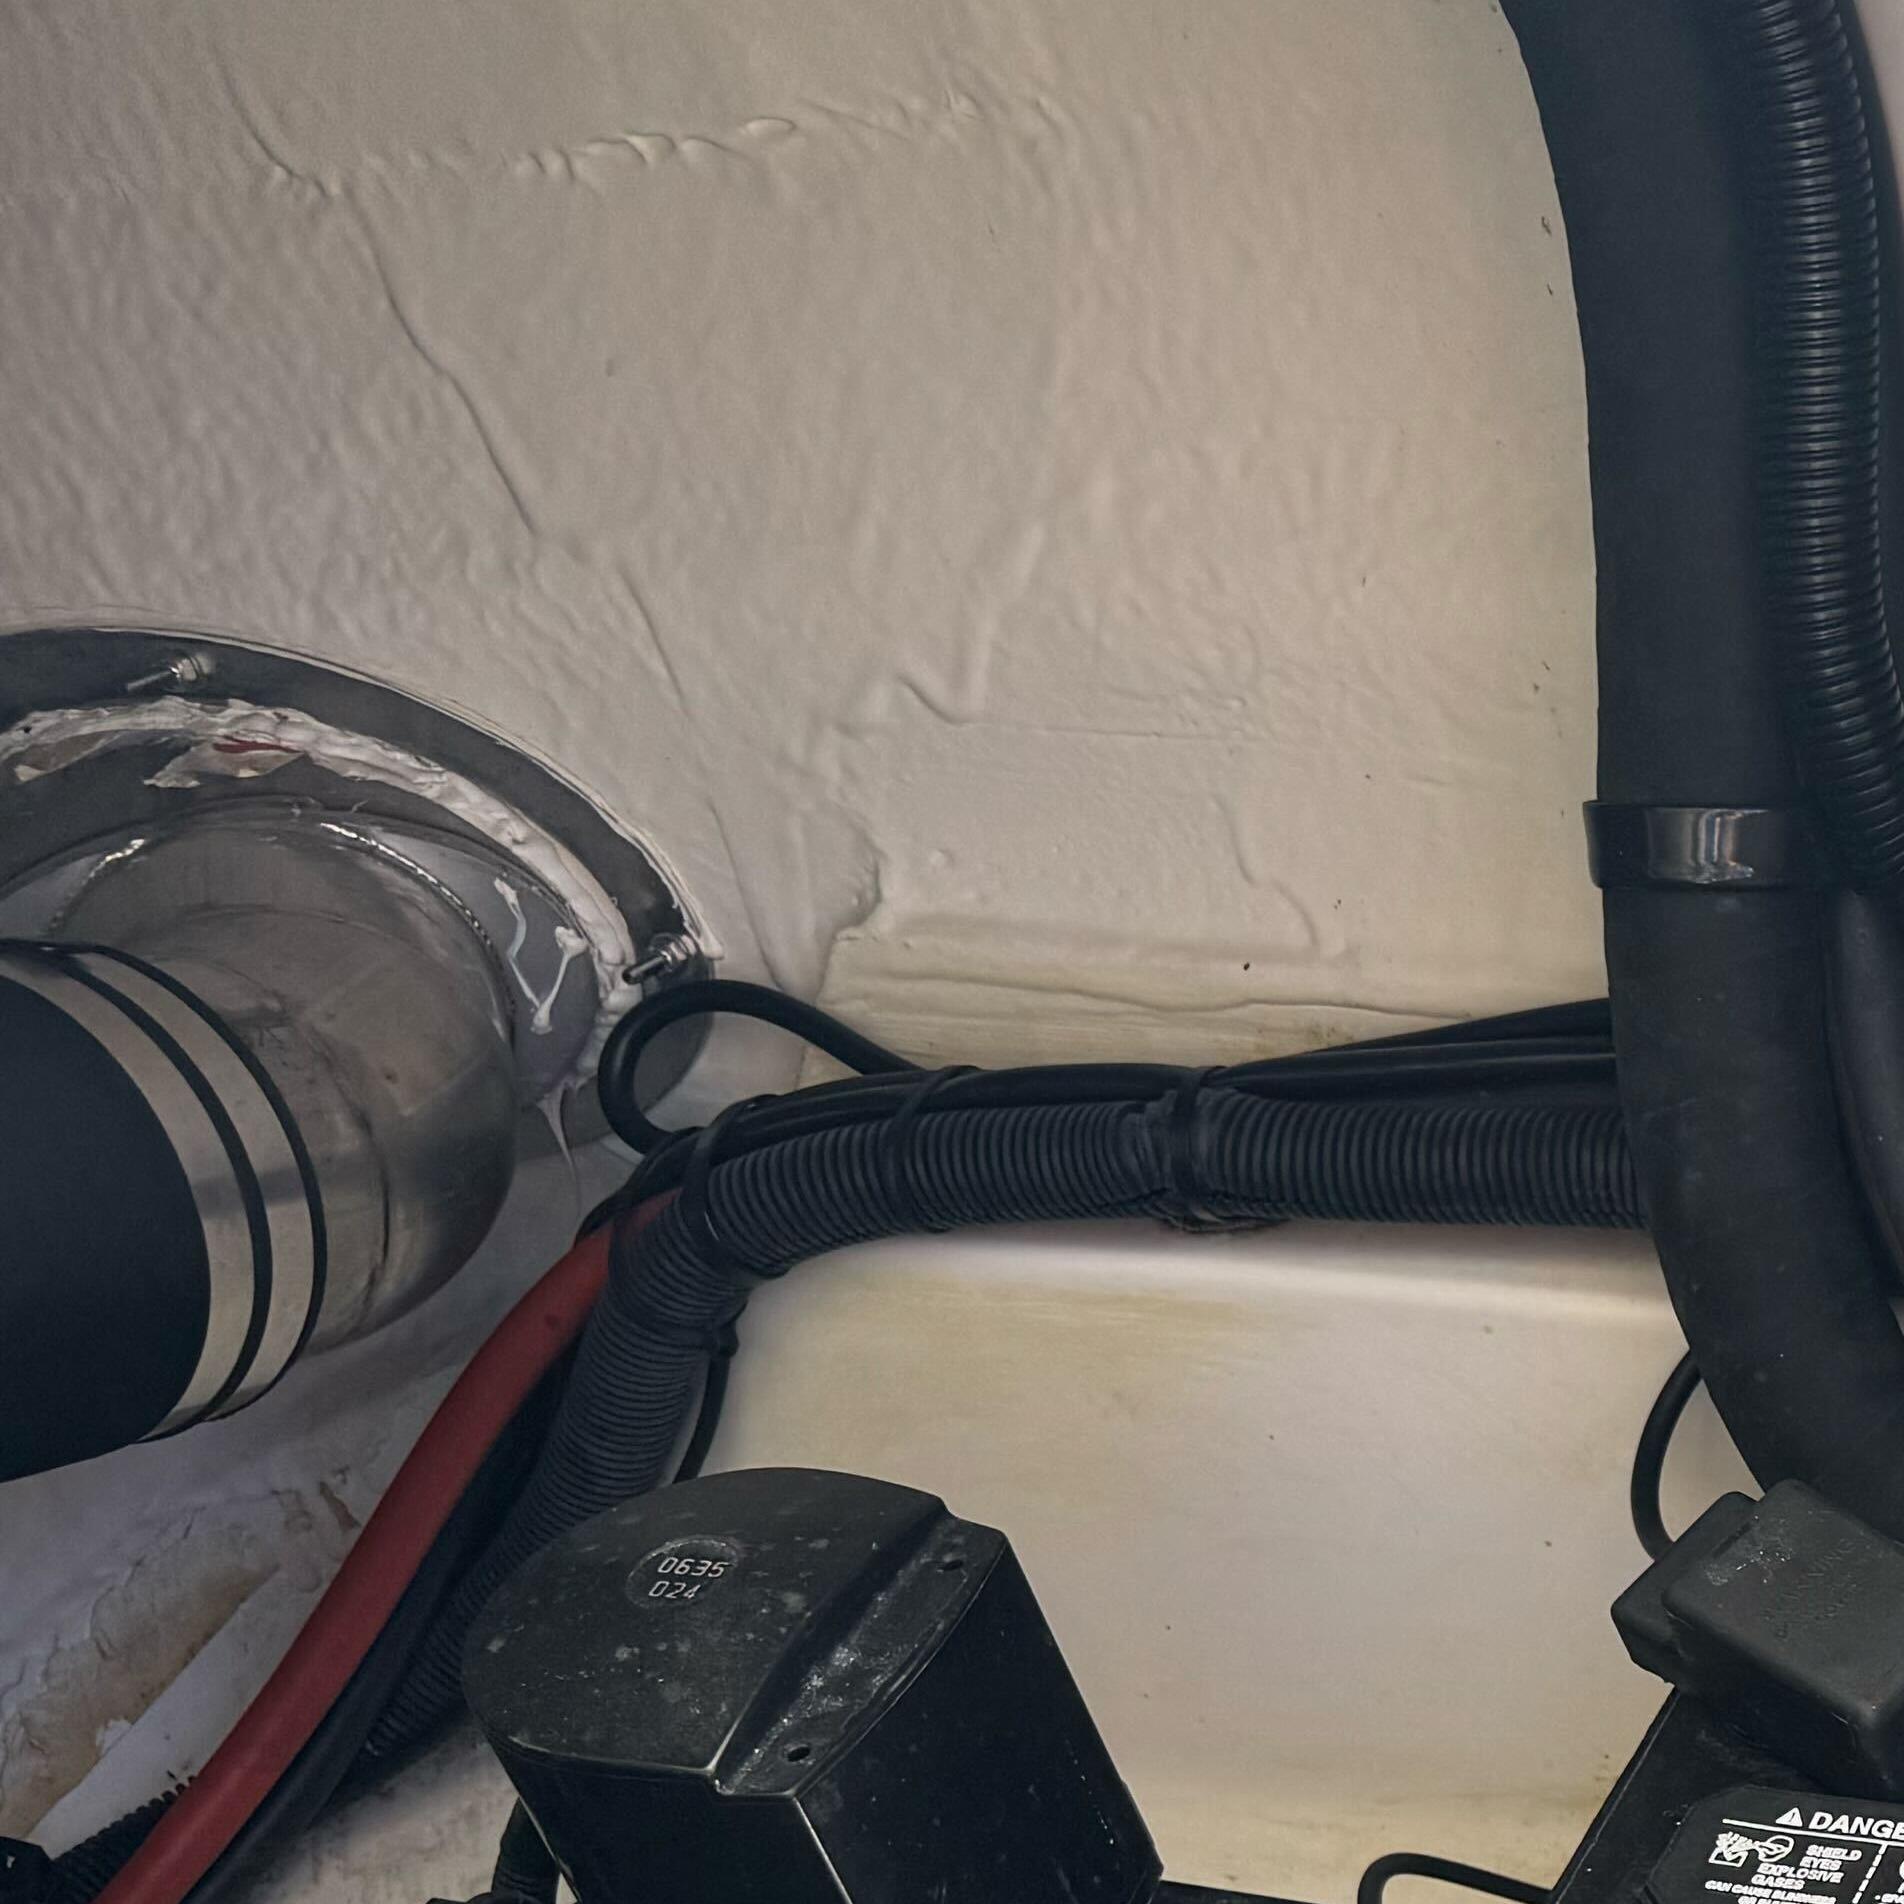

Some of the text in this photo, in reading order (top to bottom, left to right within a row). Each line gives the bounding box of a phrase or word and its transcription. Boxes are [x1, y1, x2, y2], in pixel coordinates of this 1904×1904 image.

[657, 1557, 730, 1578] 0635
[648, 1581, 702, 1599] 024
[1806, 1844, 1862, 1861] SHIELD
[1800, 1856, 1842, 1871] EYES
[1756, 1862, 1844, 1884] EXPLOSIVE
[1751, 1874, 1805, 1890] GASES
